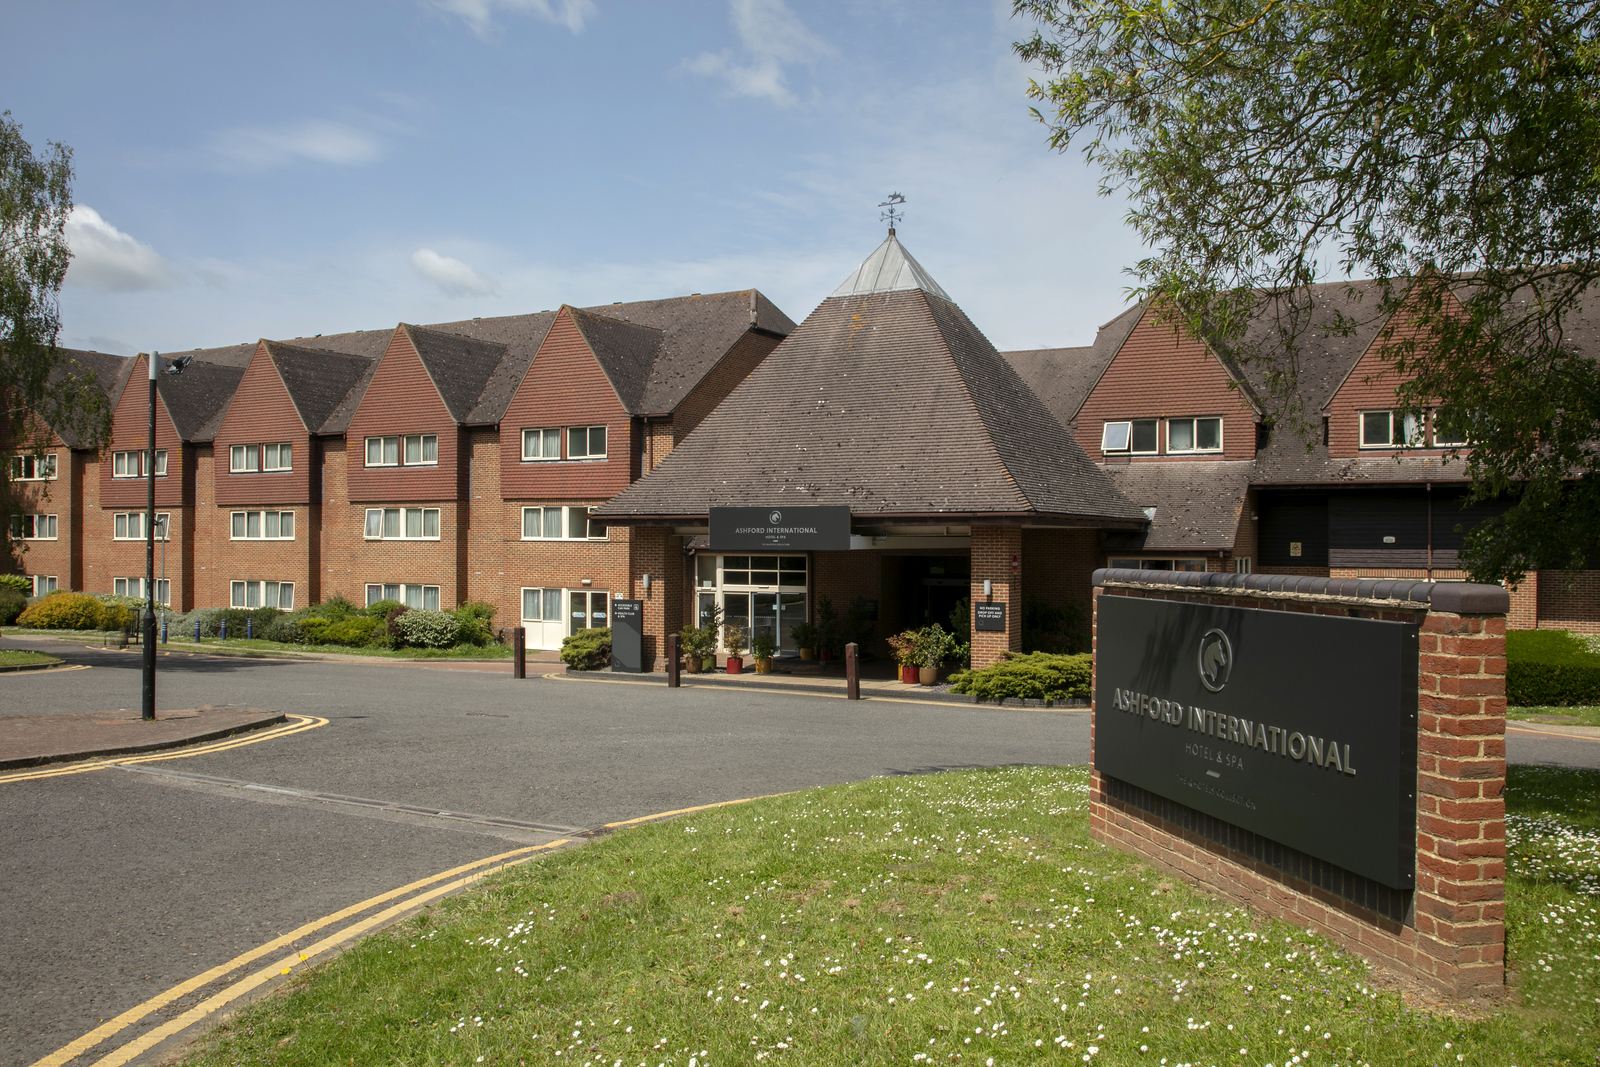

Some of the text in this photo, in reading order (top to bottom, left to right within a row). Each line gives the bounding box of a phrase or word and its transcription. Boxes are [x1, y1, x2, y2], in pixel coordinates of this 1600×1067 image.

[1112, 687, 1357, 775] ASHFORD INTERNATIONAL
[1185, 742, 1244, 770] HOTEL & SPA
